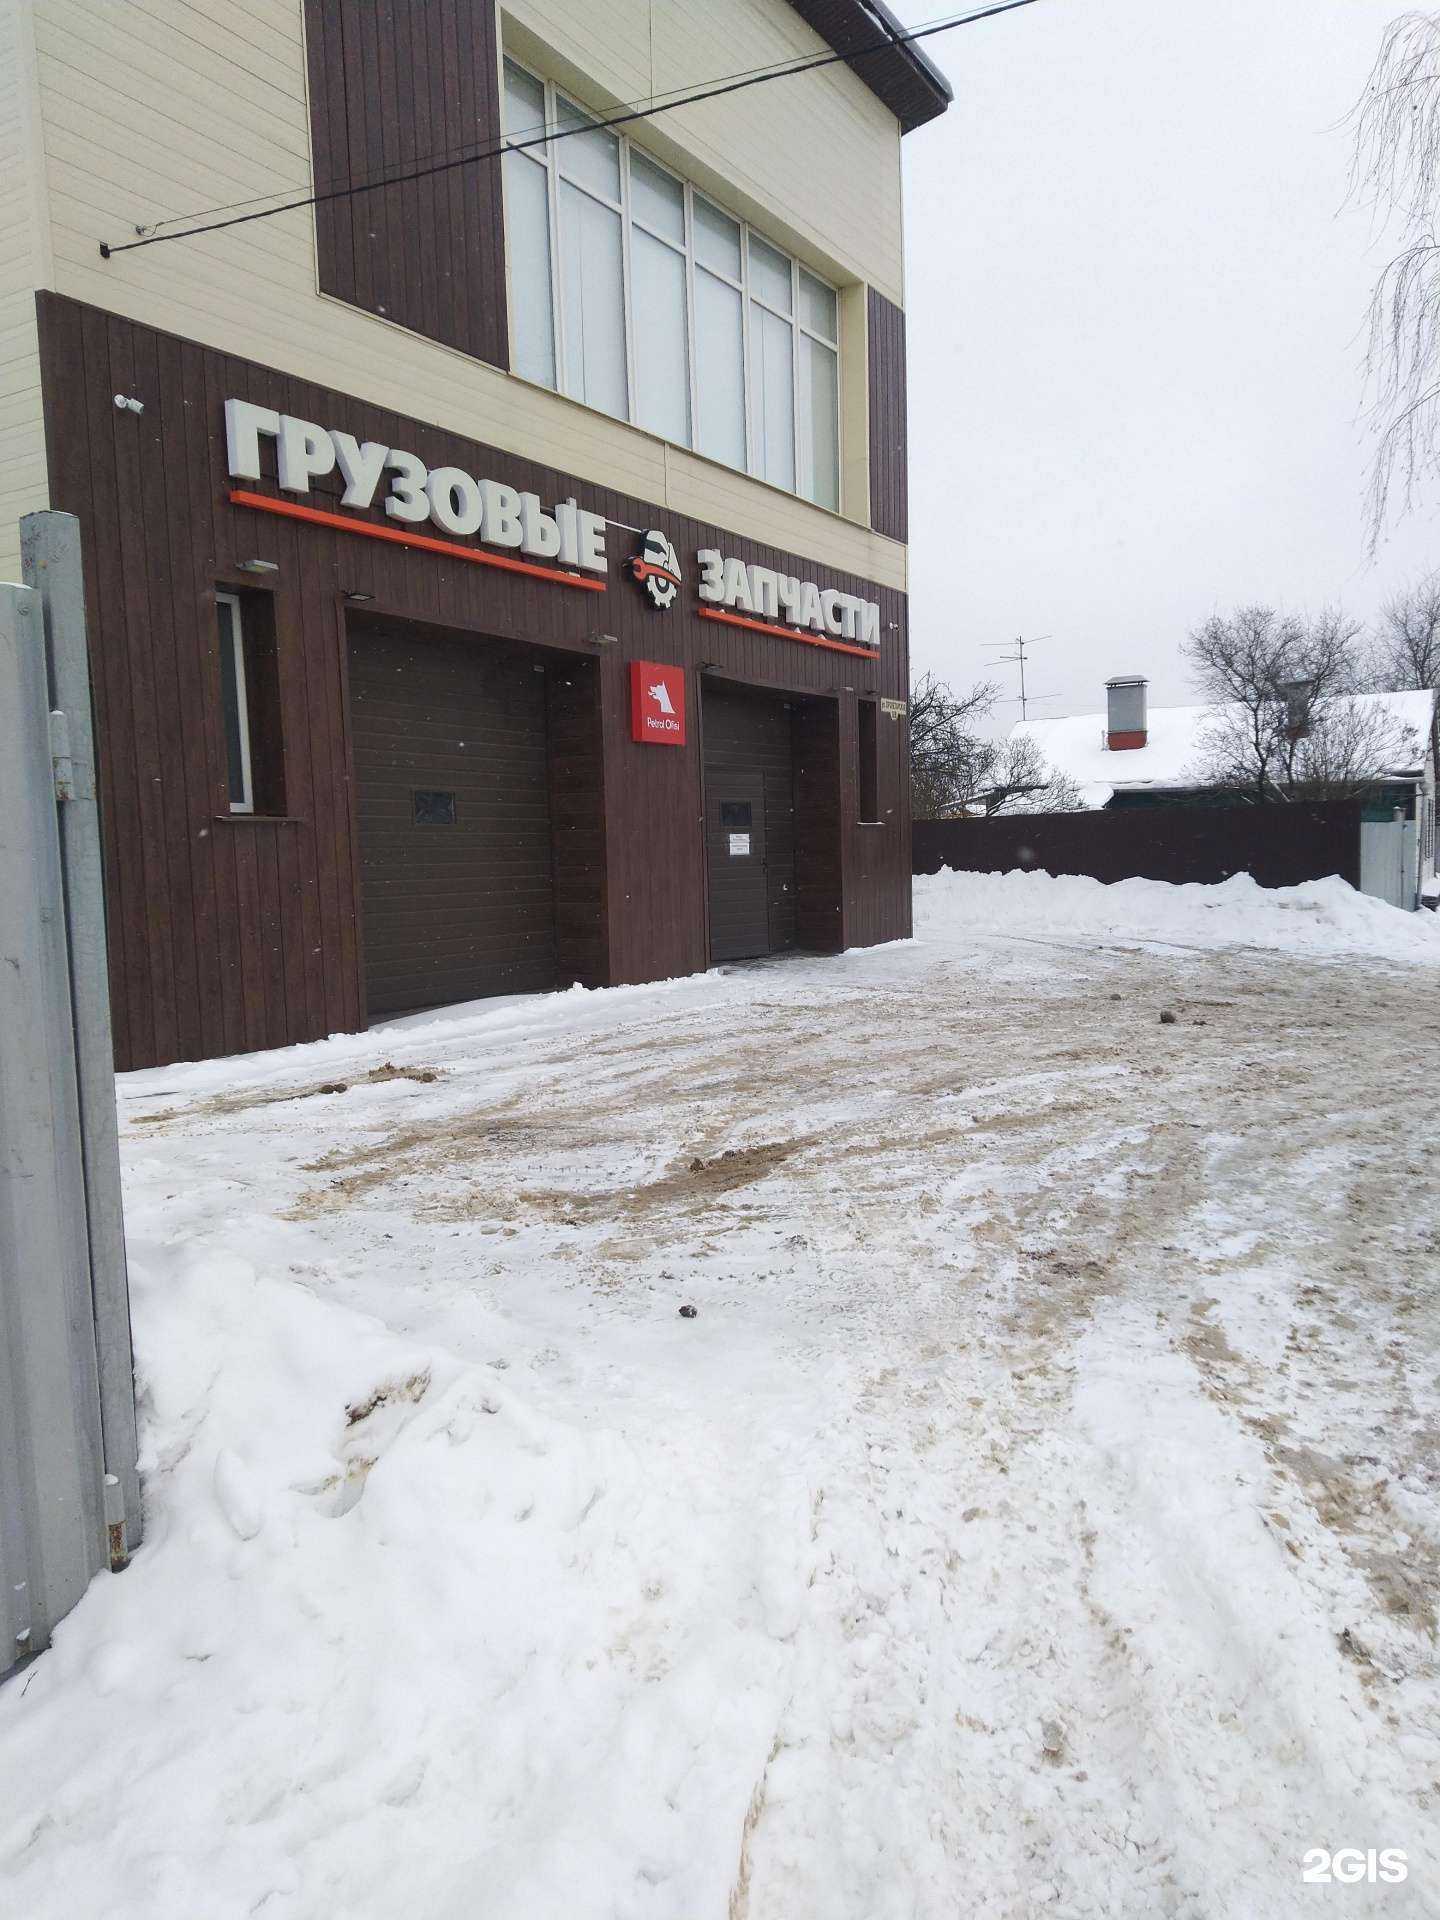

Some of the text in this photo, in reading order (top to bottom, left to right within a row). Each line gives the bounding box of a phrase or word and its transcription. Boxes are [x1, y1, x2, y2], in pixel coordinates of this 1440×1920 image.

[225, 398, 880, 645] ГРУЗОВЫЕ ЗАПЧАСТИ
[647, 717, 665, 729] Petrol
